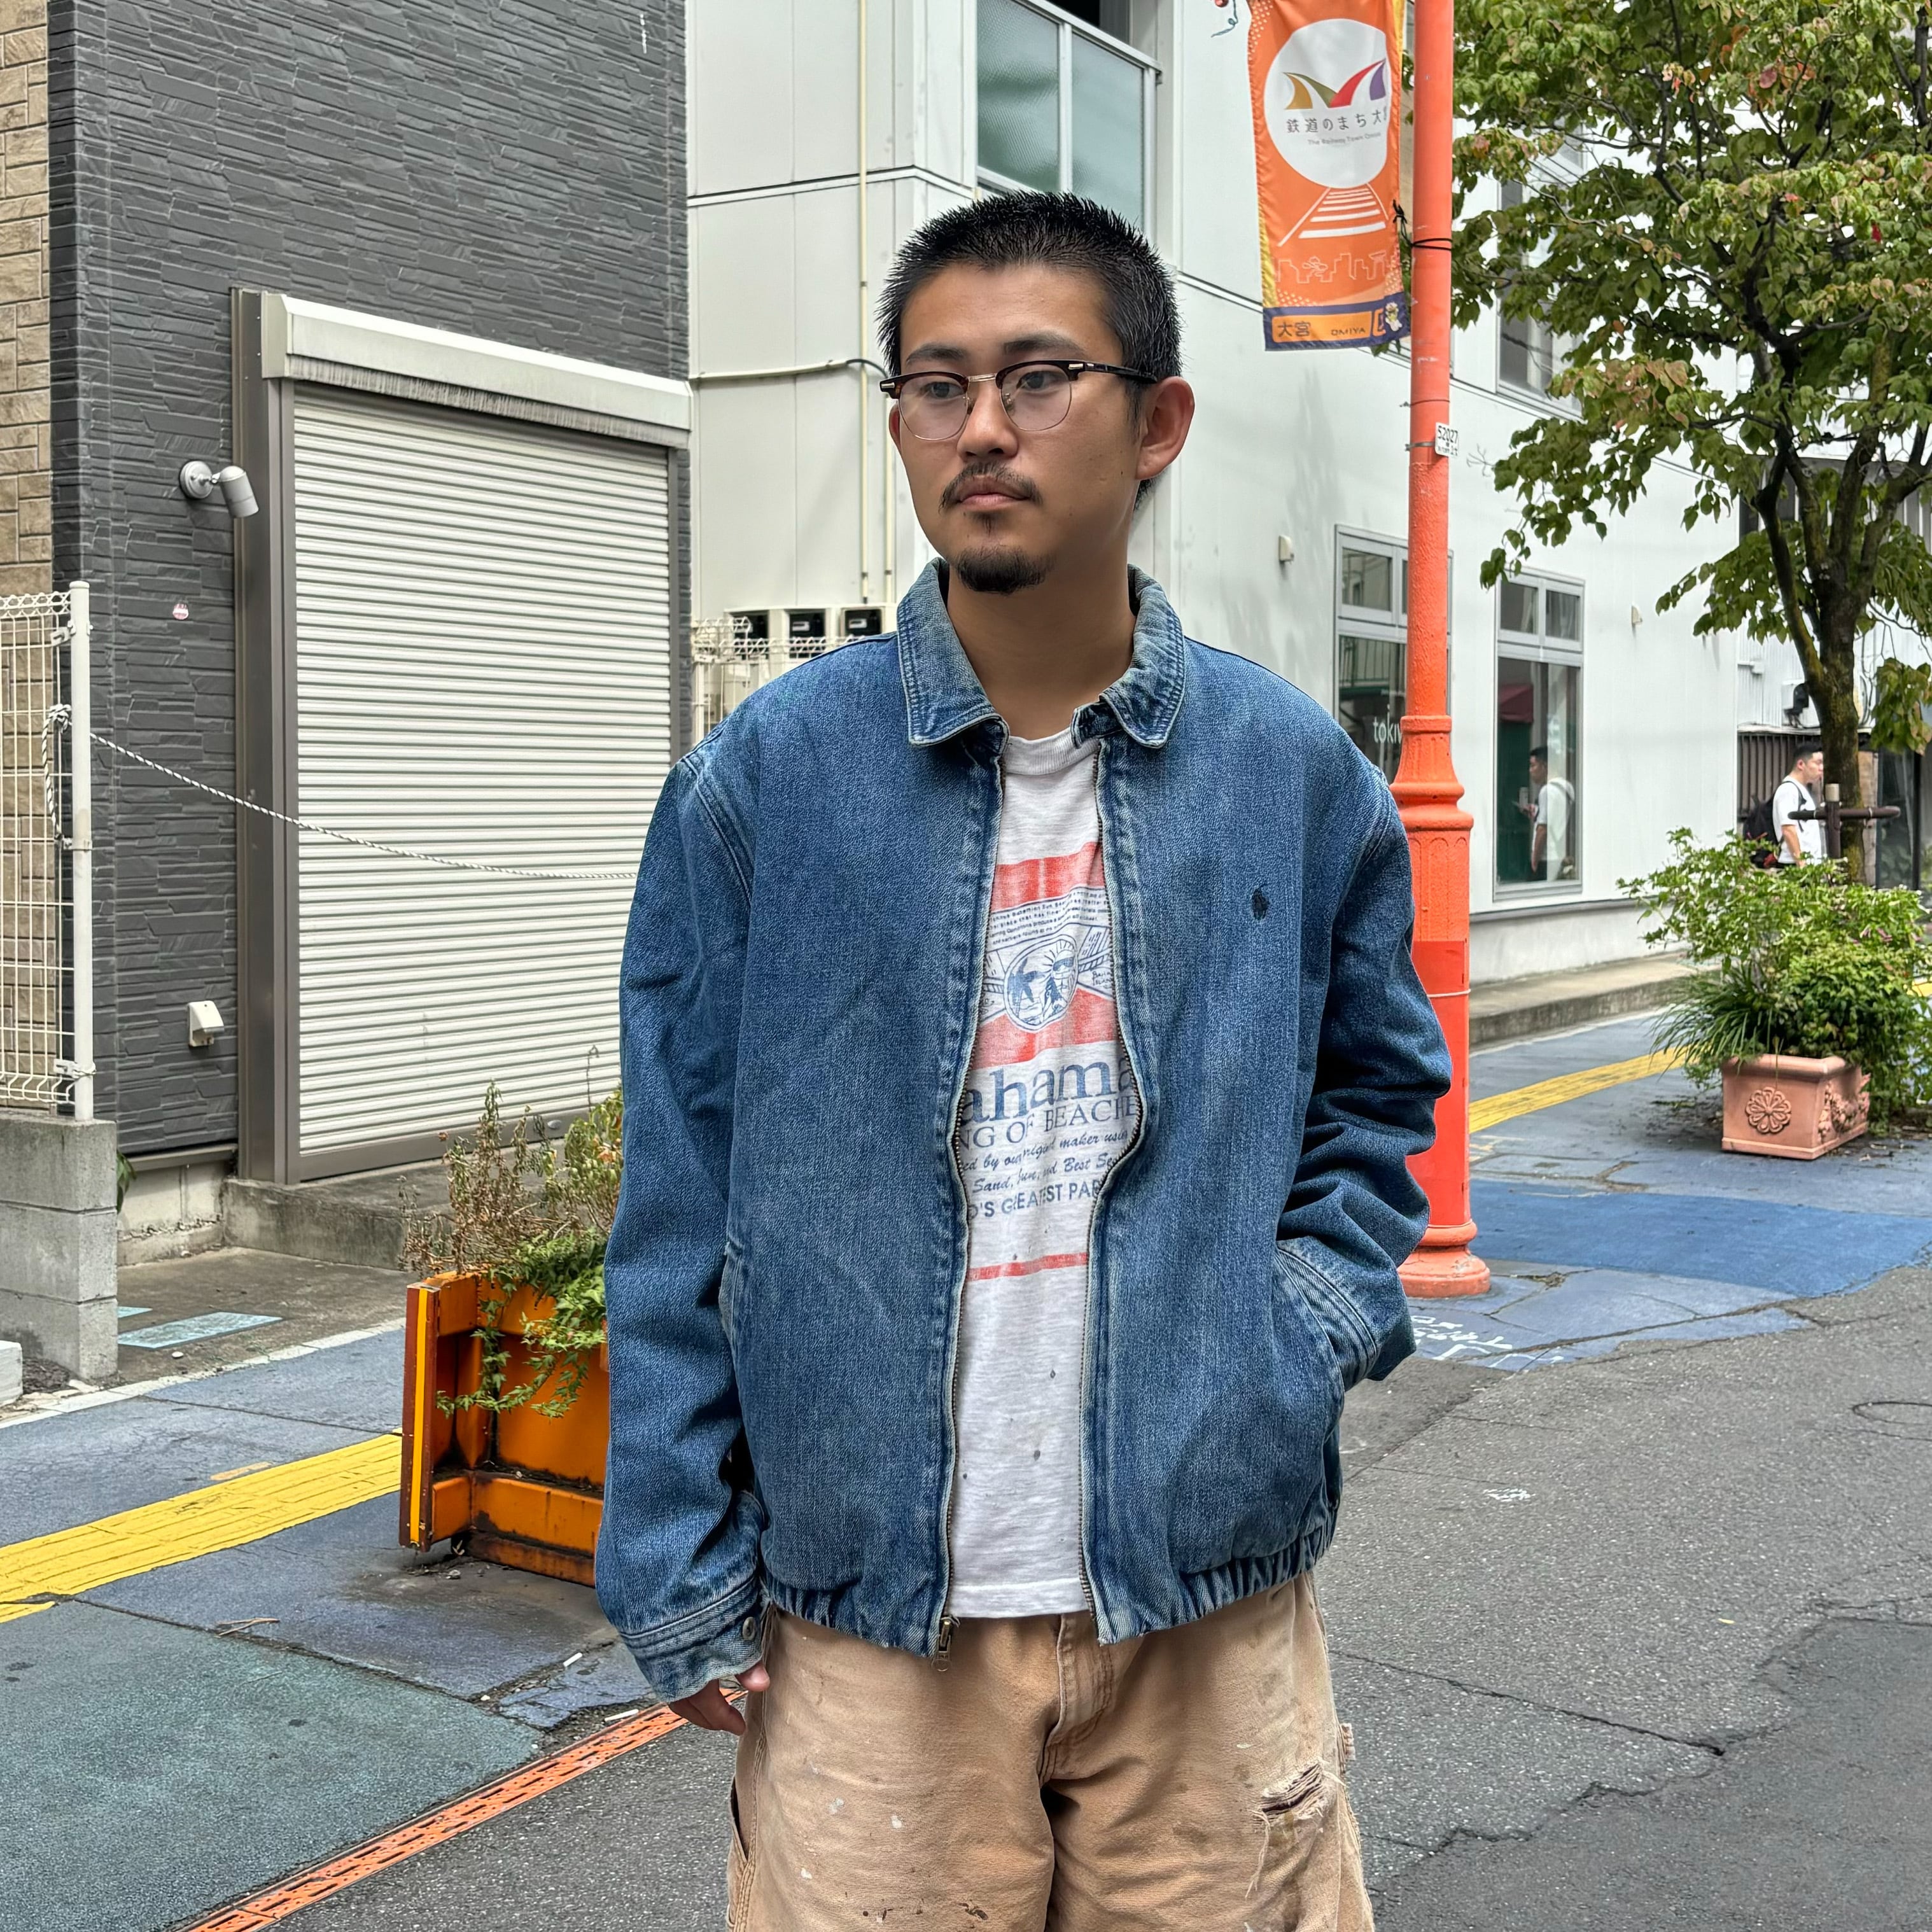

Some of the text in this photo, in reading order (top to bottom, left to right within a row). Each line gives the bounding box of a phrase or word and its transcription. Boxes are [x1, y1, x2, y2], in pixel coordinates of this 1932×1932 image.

[1277, 321, 1311, 337] 大宮
[1331, 327, 1366, 336] OMIYA
[983, 1153, 999, 1171] by
[1060, 1131, 1100, 1149] maker
[1063, 1157, 1091, 1173] Best
